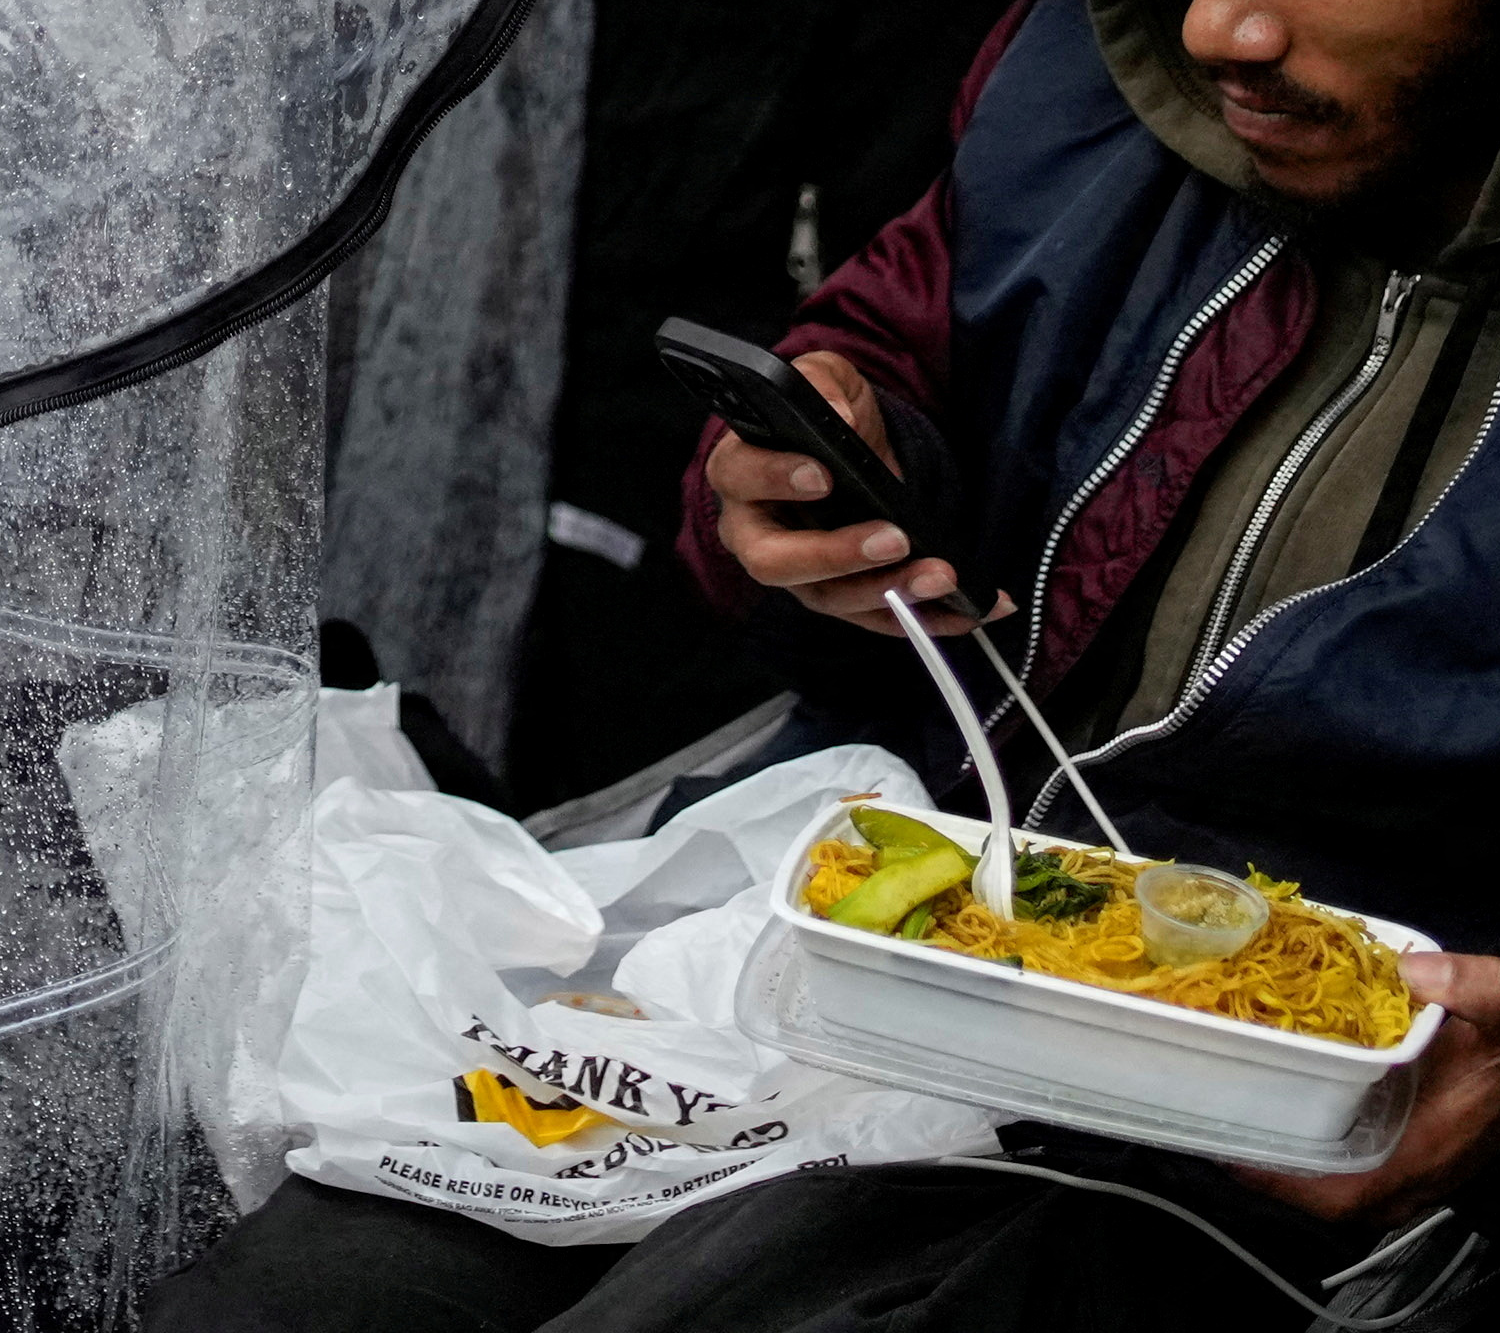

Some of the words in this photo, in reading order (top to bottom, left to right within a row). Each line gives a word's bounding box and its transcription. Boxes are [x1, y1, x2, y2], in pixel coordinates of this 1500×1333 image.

[378, 1155, 443, 1189] PLEASE
[446, 1179, 505, 1201] REUSE
[510, 1186, 535, 1203] OR
[588, 1208, 605, 1219] AND
